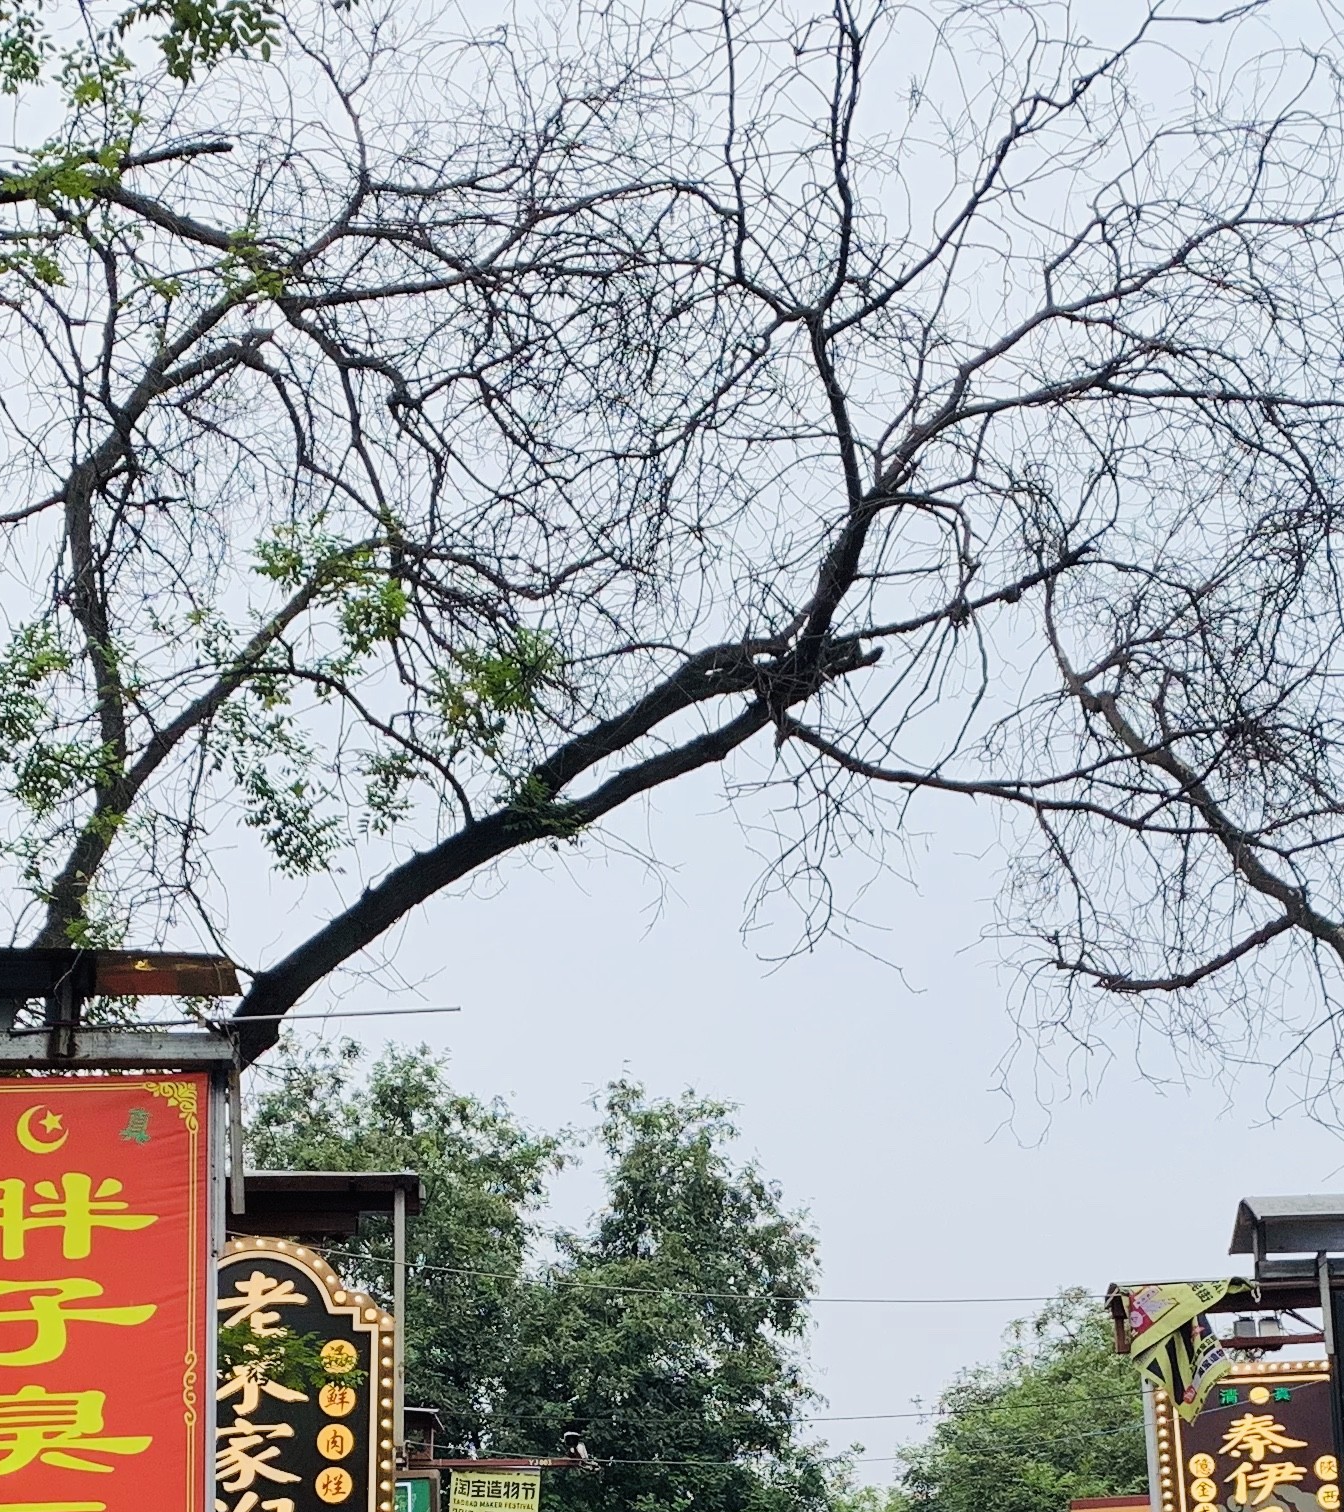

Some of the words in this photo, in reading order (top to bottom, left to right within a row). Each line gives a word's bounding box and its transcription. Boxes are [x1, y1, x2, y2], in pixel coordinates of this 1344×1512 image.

[453, 1477, 537, 1501] 淘宝造物节
[479, 1500, 504, 1510] MAKER
[504, 1501, 535, 1512] FESTIVAL
